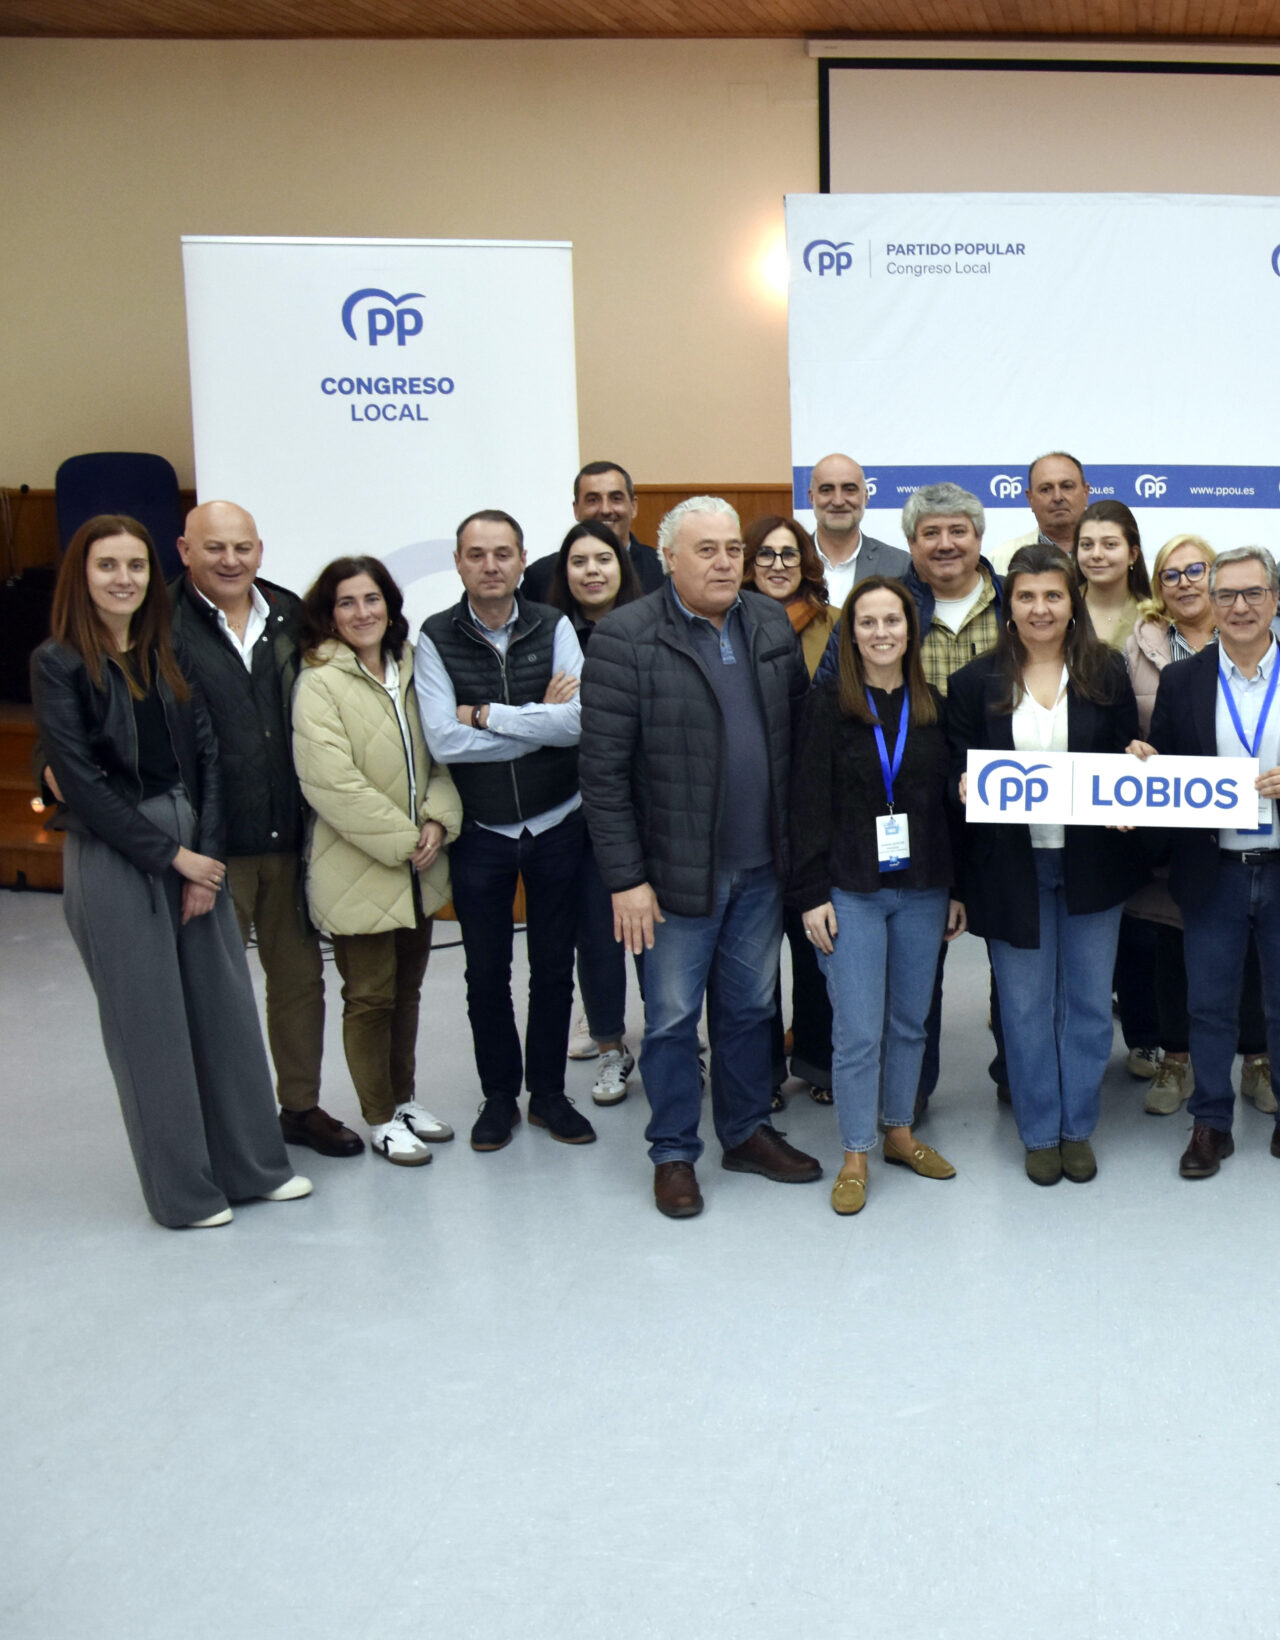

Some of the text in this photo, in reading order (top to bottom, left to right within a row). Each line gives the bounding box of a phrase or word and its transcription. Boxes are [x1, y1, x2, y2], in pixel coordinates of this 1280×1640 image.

[886, 243, 1026, 256] PARTIDO POPULAR
[886, 261, 991, 277] Congreso Local
[320, 376, 455, 395] CONGRESO
[350, 403, 429, 422] LOCAL
[1190, 486, 1255, 496] www.ppou.es
[1092, 774, 1239, 810] LOBIOS
